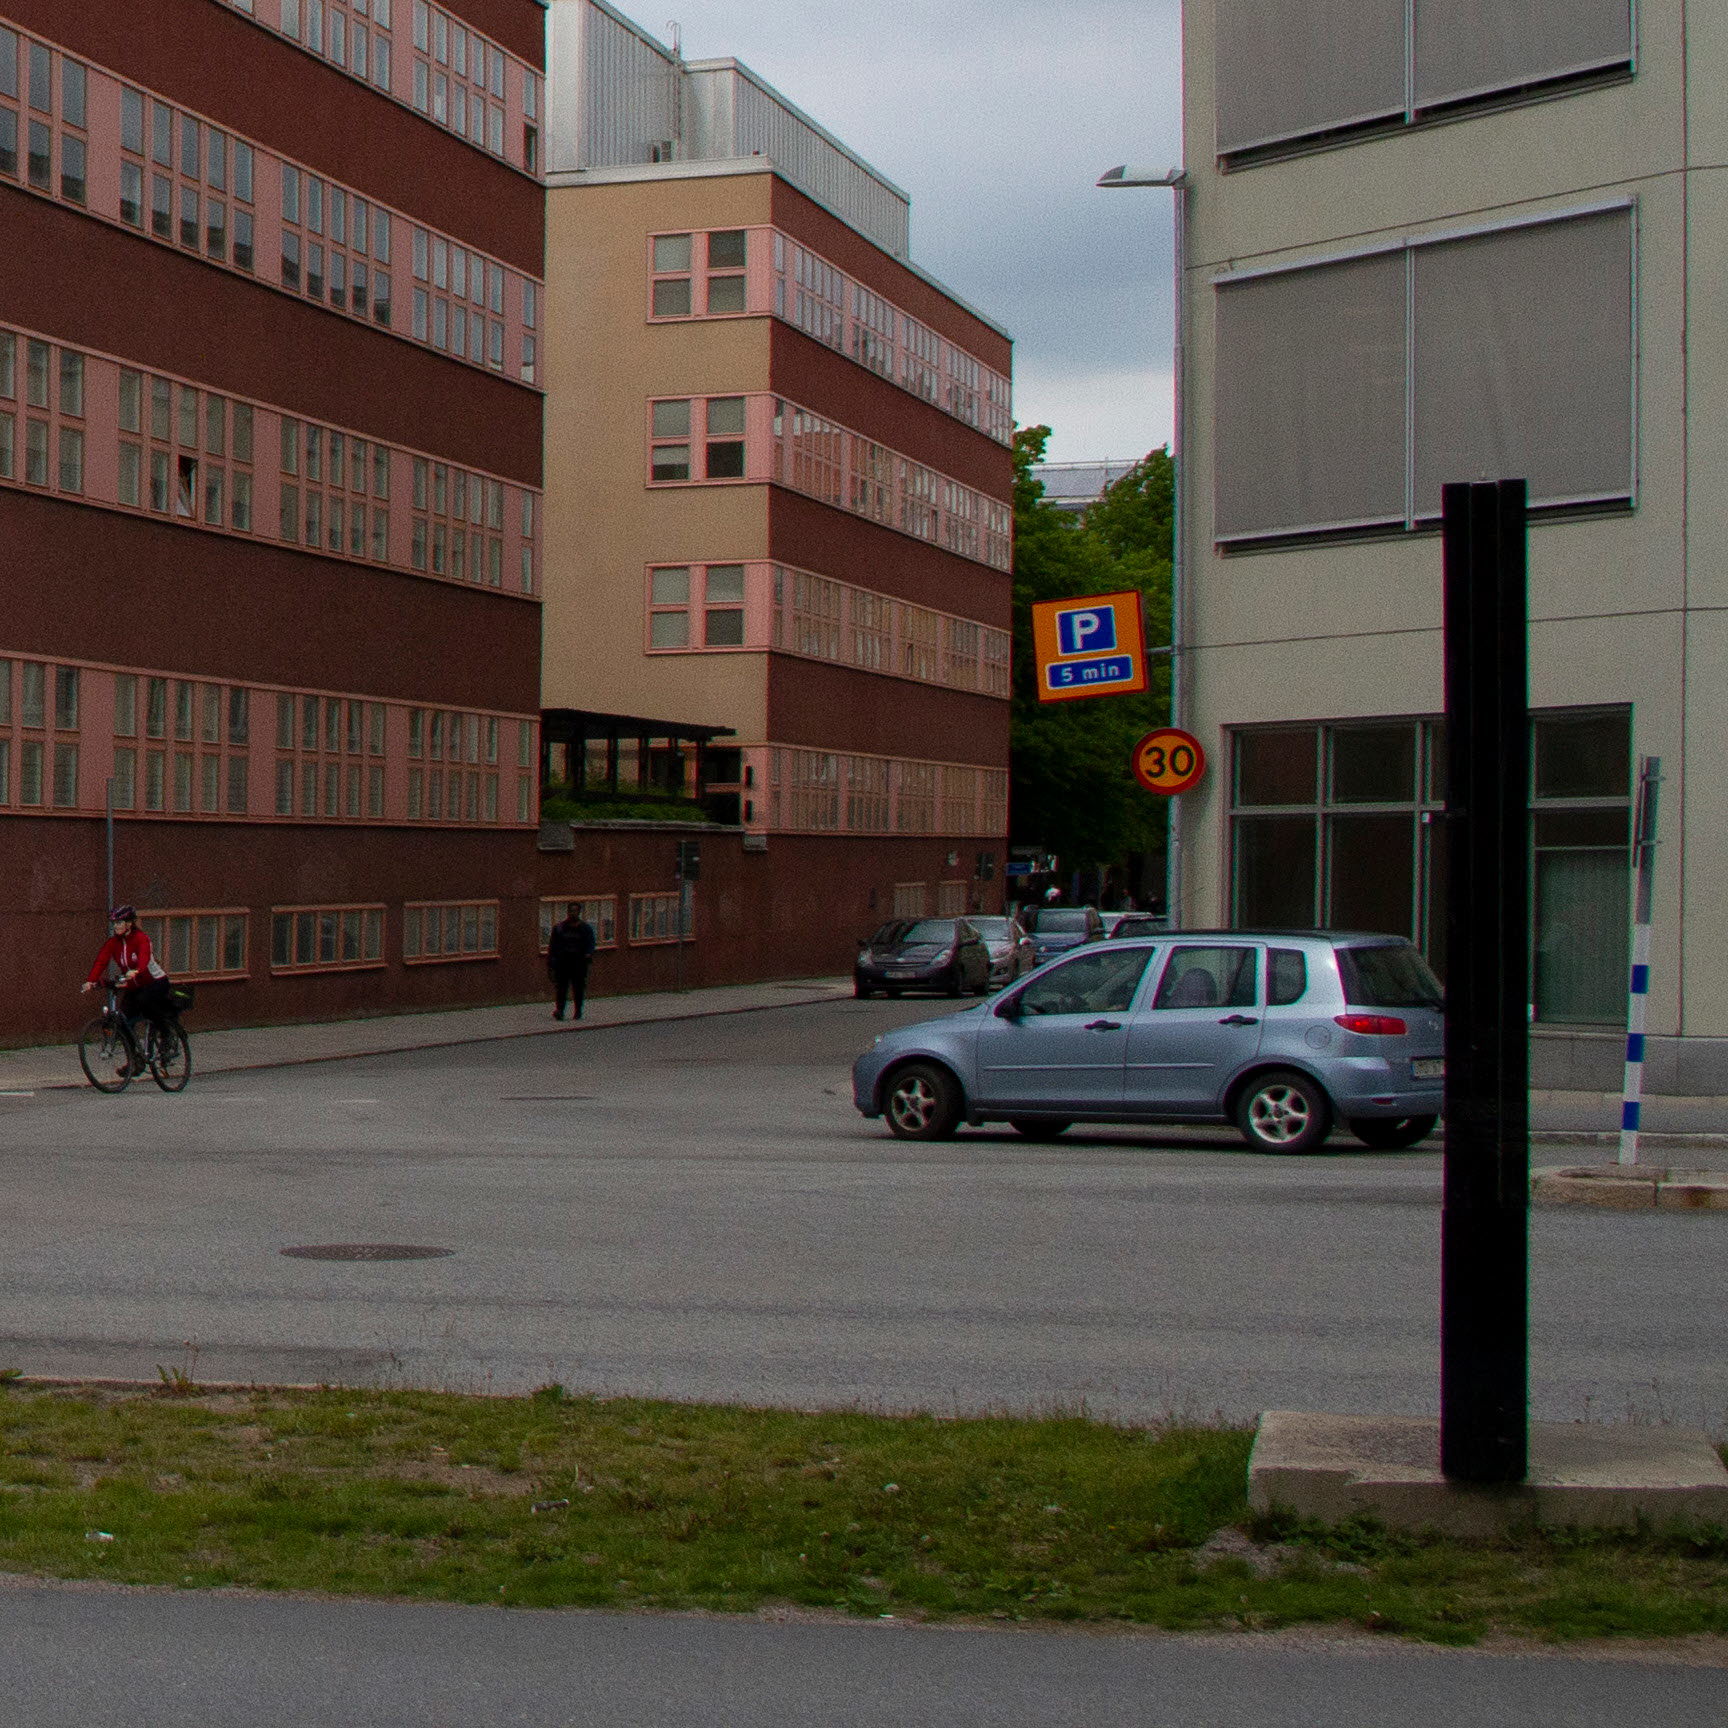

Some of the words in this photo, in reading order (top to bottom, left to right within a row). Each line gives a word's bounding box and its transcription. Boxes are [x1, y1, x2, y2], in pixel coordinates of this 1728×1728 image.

[1071, 612, 1100, 650] P
[1061, 667, 1074, 683] 5
[1081, 662, 1121, 681] min
[1144, 744, 1195, 779] 30
